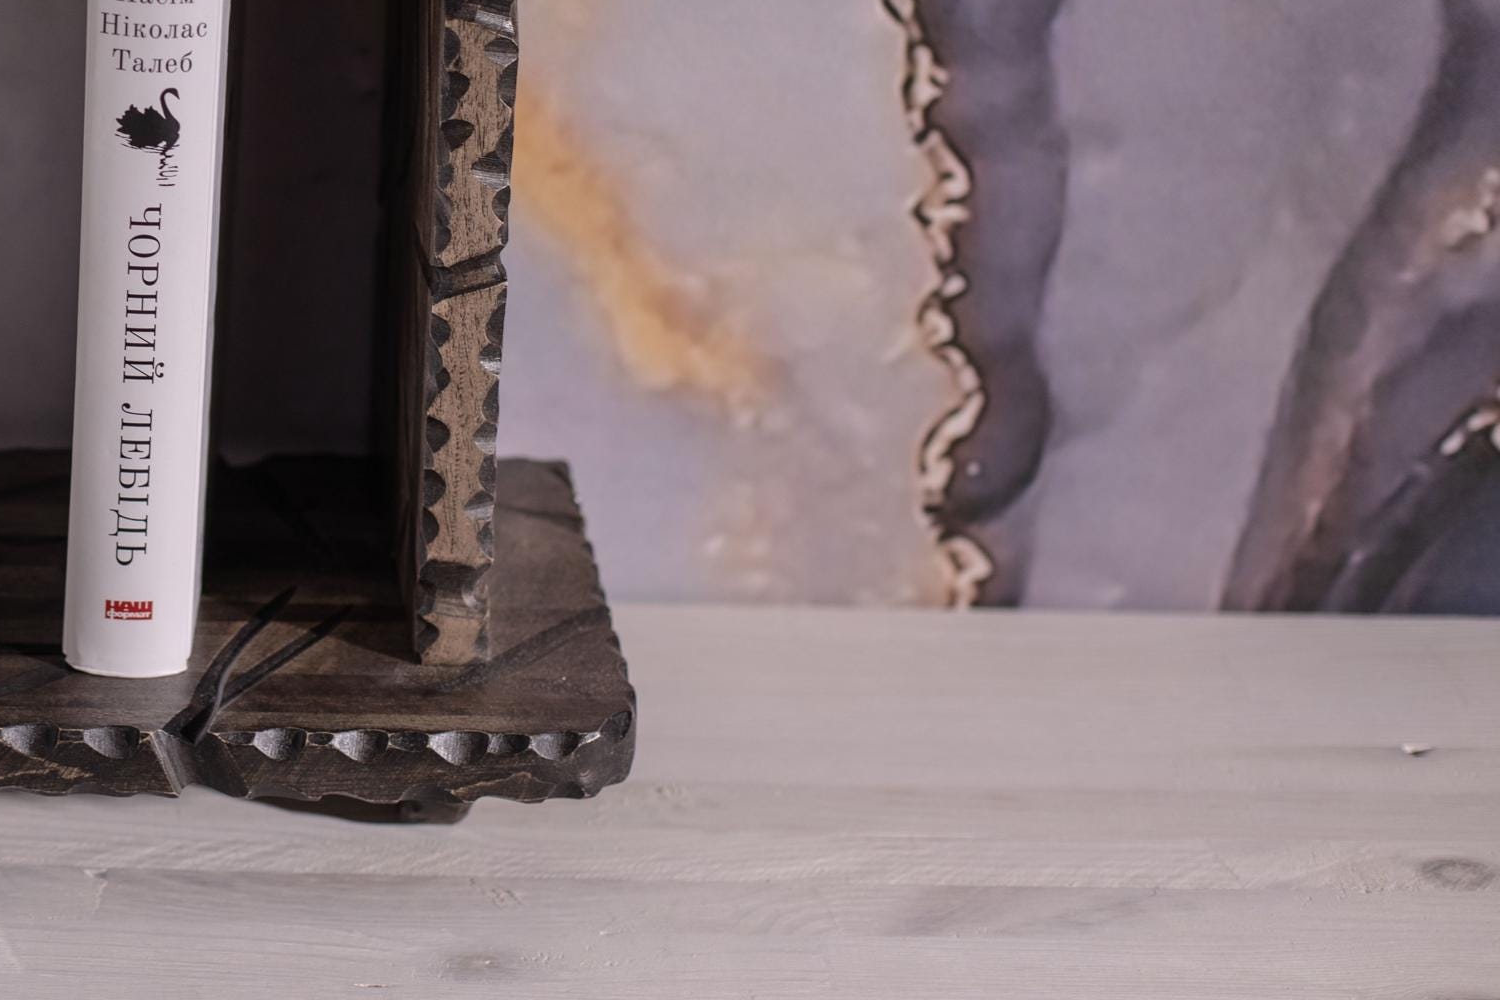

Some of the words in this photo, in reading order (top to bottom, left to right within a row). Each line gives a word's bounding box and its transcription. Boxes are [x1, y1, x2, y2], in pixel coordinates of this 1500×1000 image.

[99, 11, 208, 39] Ніколас
[112, 48, 193, 74] Талеб
[122, 203, 164, 384] ЧОРНИЙ
[108, 402, 153, 567] ЛЕБІДЬ
[105, 600, 153, 613] НАШ
